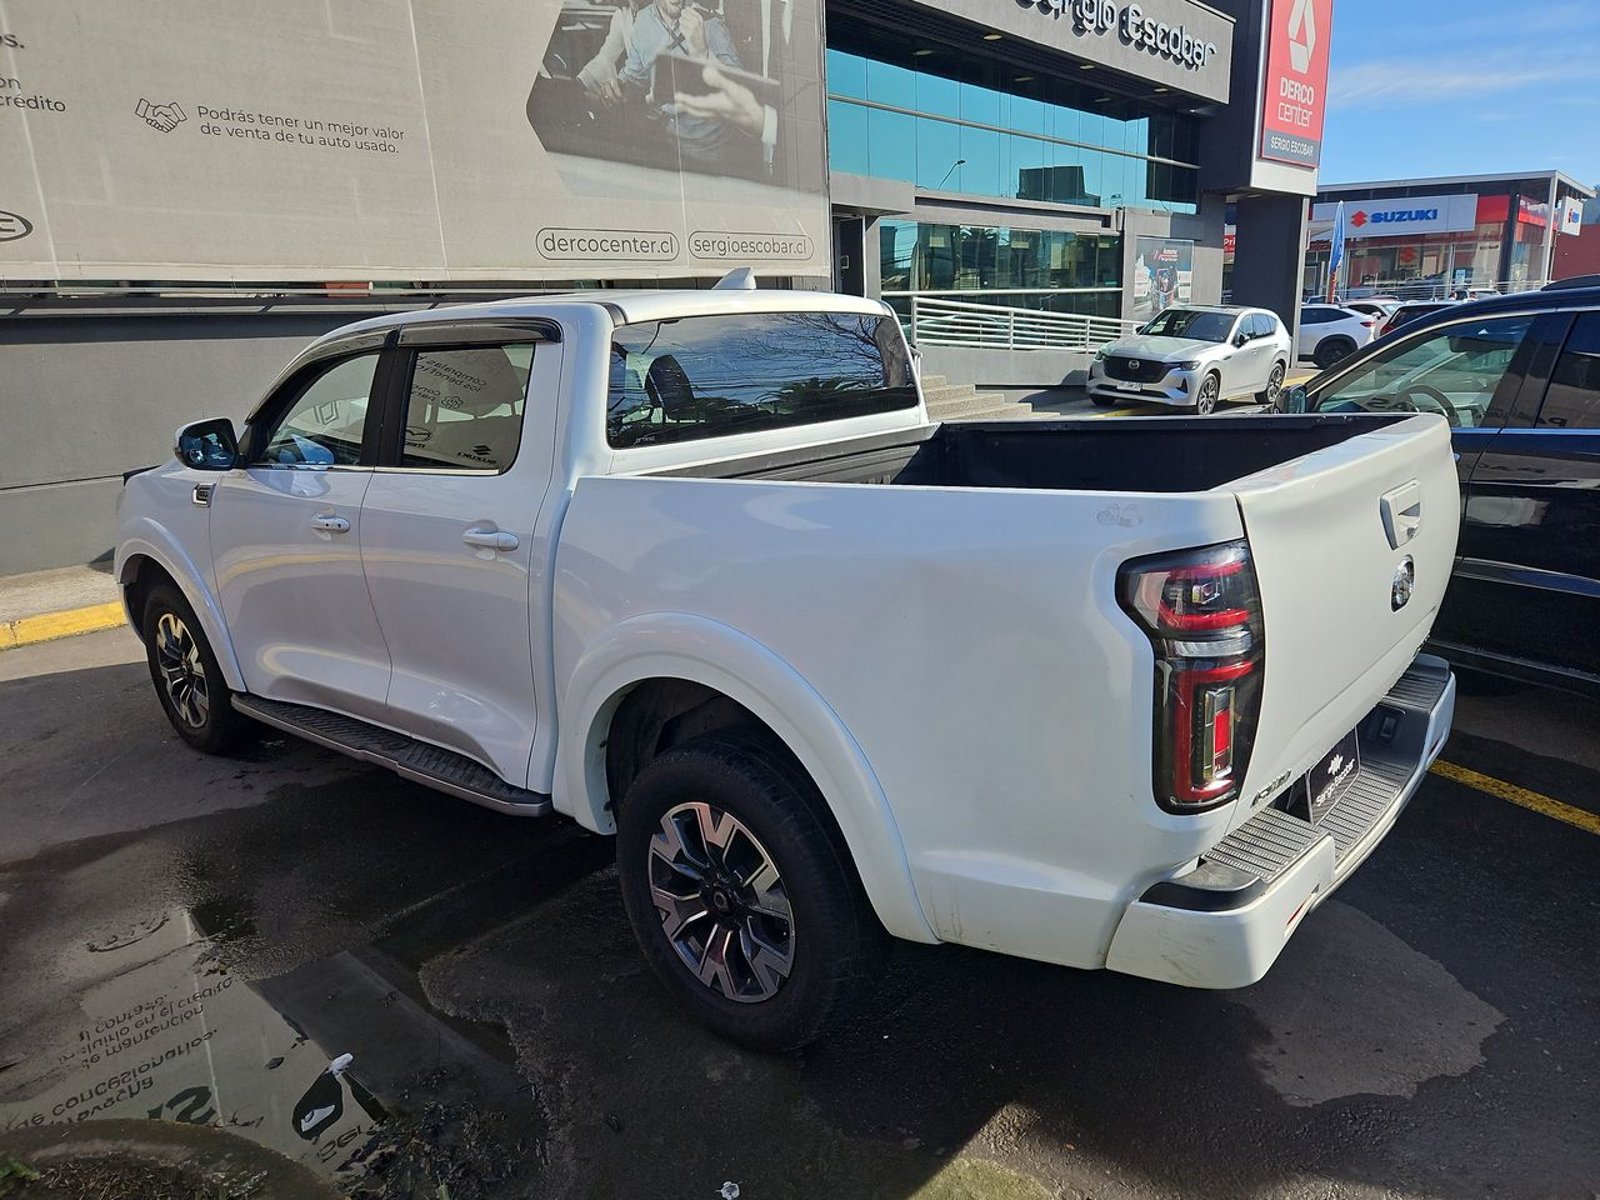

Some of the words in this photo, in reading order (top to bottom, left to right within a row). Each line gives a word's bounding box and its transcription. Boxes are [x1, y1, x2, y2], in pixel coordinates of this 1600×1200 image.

[1120, 3, 1216, 70] Escobar
[1280, 76, 1315, 106] DERCO
[198, 105, 255, 124] Podrás
[258, 113, 299, 128] tener
[304, 119, 324, 131] un
[328, 122, 369, 137] mejor
[372, 126, 404, 140] valor
[200, 122, 221, 136] de
[225, 127, 271, 141] venta
[275, 129, 295, 143] de
[298, 132, 314, 145] tu
[318, 136, 351, 149] auto
[354, 140, 399, 154] usado.
[1270, 136, 1291, 152] SERGIO
[1290, 140, 1314, 157] ESCOBAR
[1370, 208, 1438, 224] SUZUKI
[543, 233, 674, 254] dercocenter.cl
[694, 236, 807, 257] sergioescobar.cl
